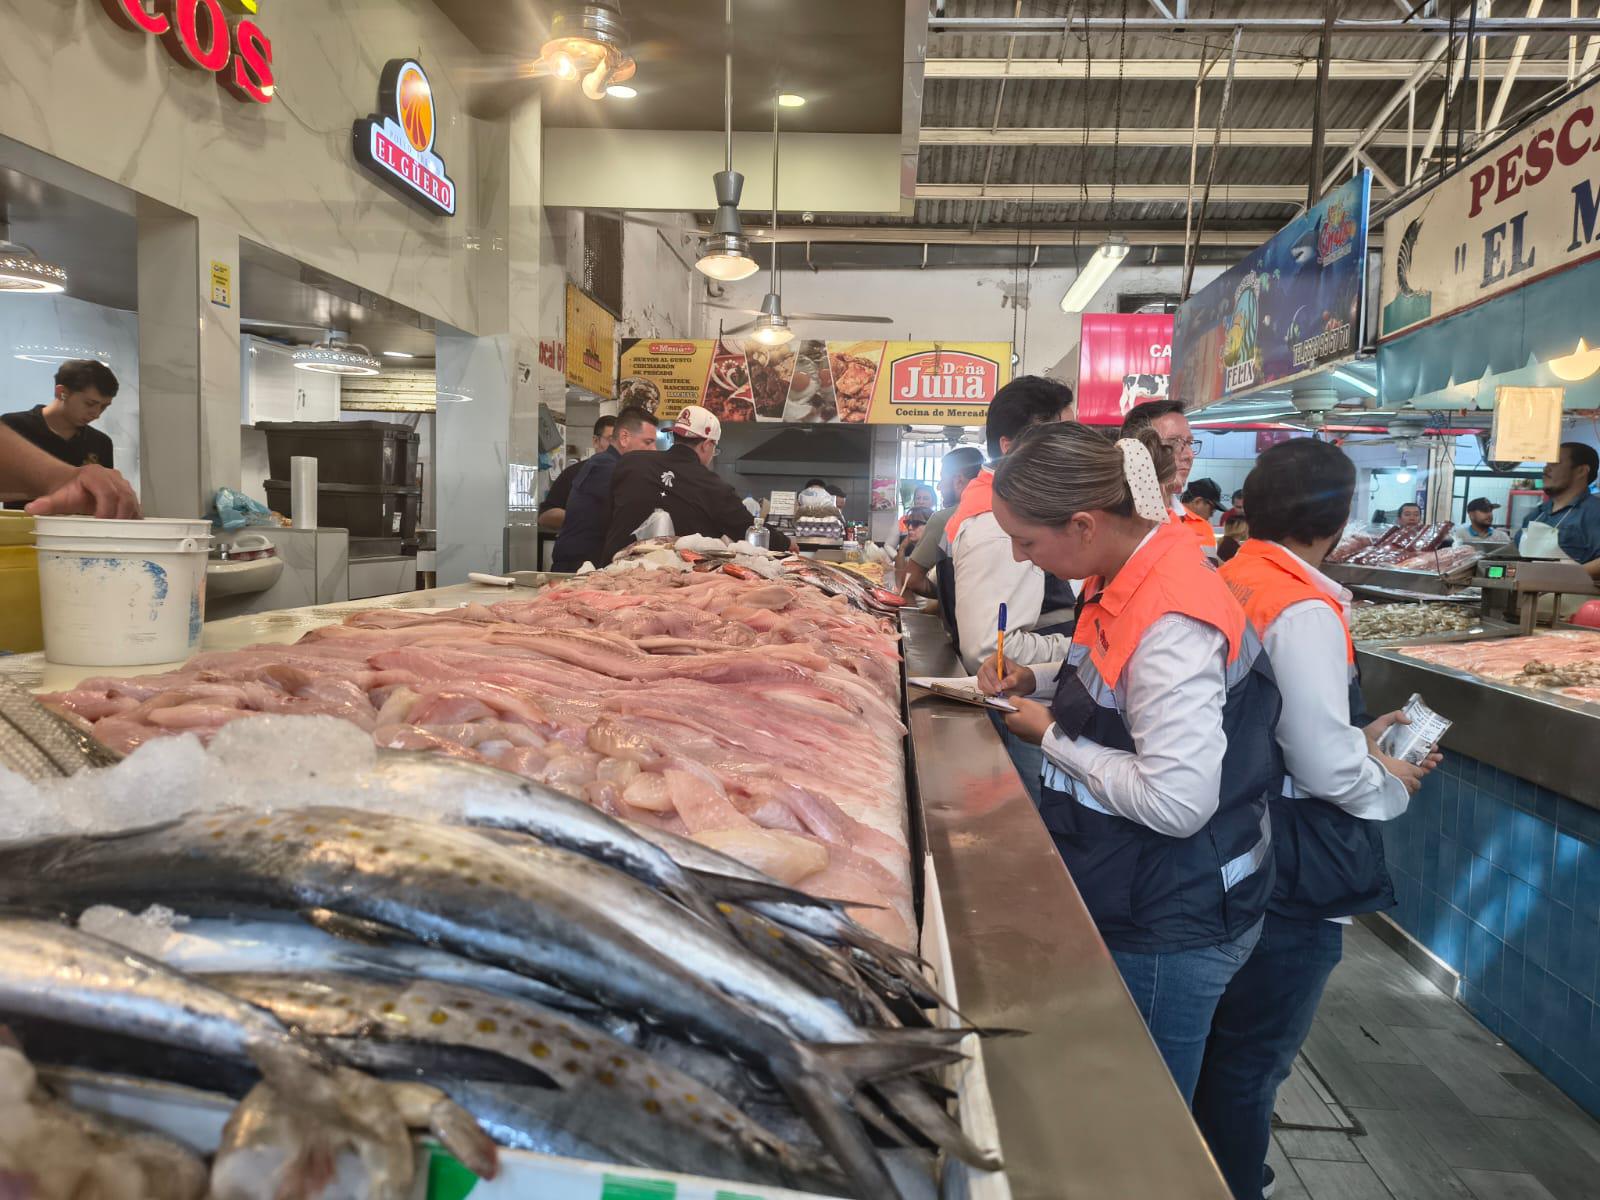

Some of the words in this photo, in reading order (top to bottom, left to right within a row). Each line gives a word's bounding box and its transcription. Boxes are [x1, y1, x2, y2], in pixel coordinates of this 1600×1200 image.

[377, 138, 396, 168] EL
[400, 156, 449, 205] GÜERO
[1468, 106, 1600, 218] PESC
[896, 408, 930, 417] Cocina
[933, 408, 944, 417] de
